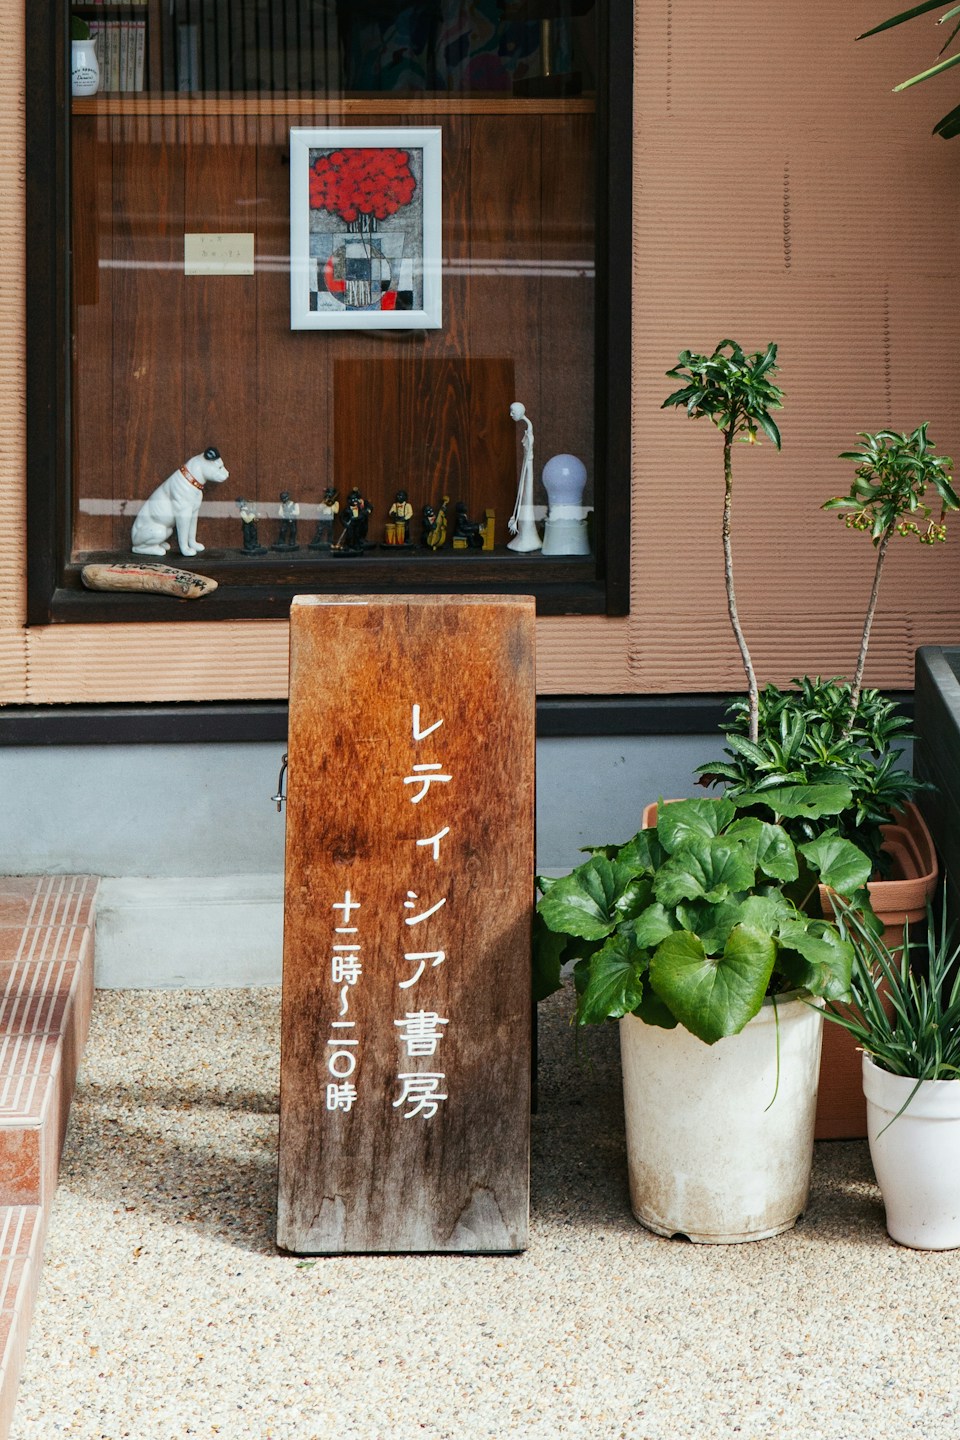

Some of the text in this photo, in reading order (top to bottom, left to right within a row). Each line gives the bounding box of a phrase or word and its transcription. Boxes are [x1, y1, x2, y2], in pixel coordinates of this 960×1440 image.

[393, 704, 453, 1119] レティシア書房
